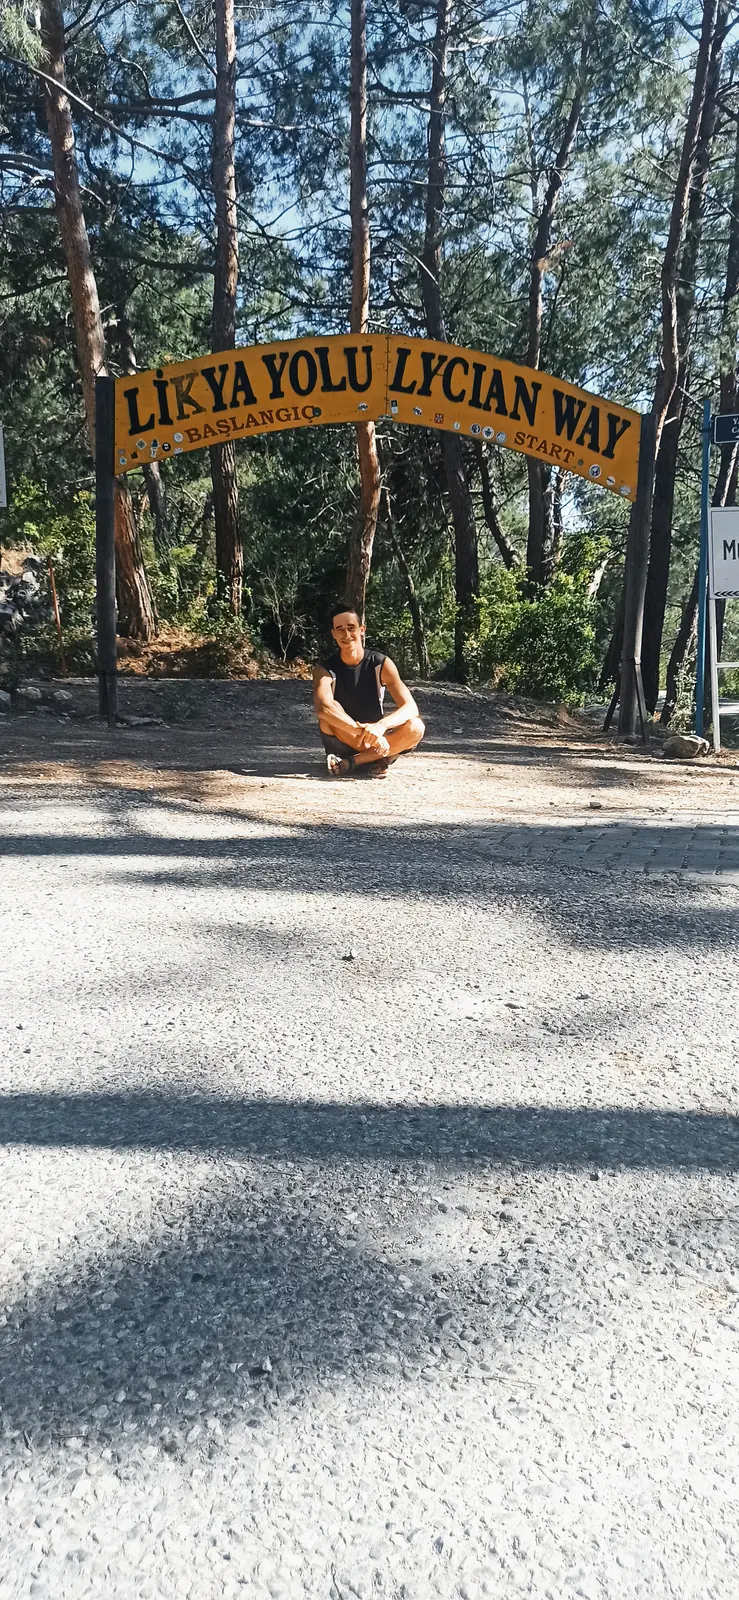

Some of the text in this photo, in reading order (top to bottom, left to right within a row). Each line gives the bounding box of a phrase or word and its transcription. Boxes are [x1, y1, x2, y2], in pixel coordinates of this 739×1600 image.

[123, 345, 373, 436] LİKYA YOLU
[389, 347, 632, 460] LYCIAN WAY
[184, 404, 317, 444] BAŞLANGIÇ
[513, 431, 575, 464] START
[723, 539, 739, 561] M
